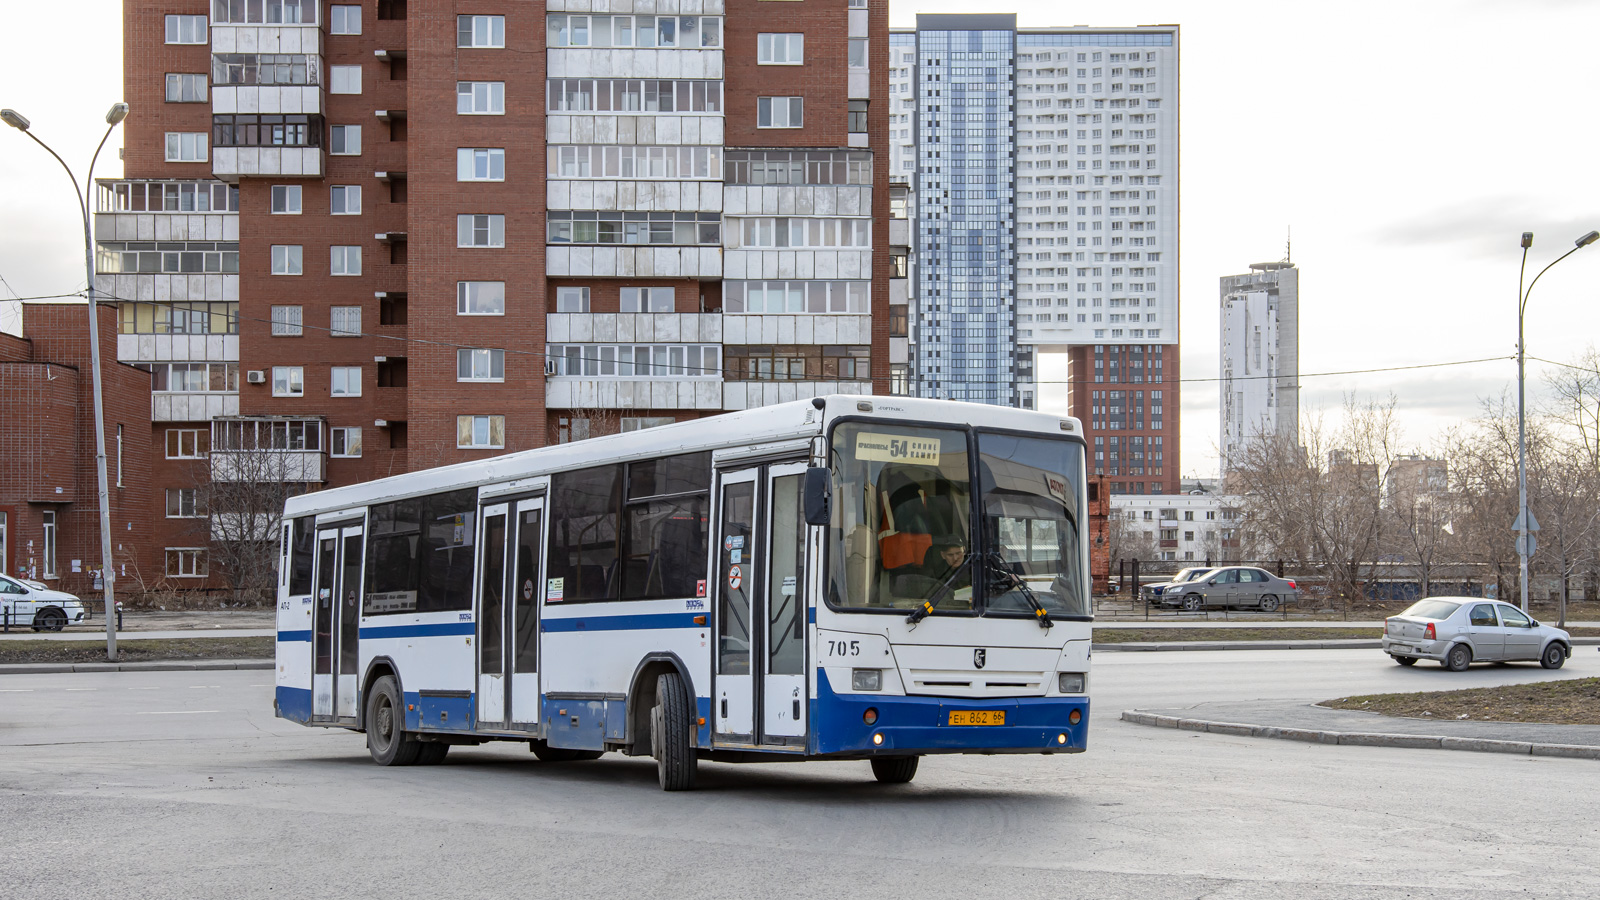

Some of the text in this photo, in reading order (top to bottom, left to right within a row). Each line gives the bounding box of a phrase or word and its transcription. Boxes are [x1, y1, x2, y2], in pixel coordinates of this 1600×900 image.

[890, 440, 908, 458] 54
[828, 640, 860, 657] 705
[969, 712, 988, 724] 862
[992, 712, 1002, 721] 66
